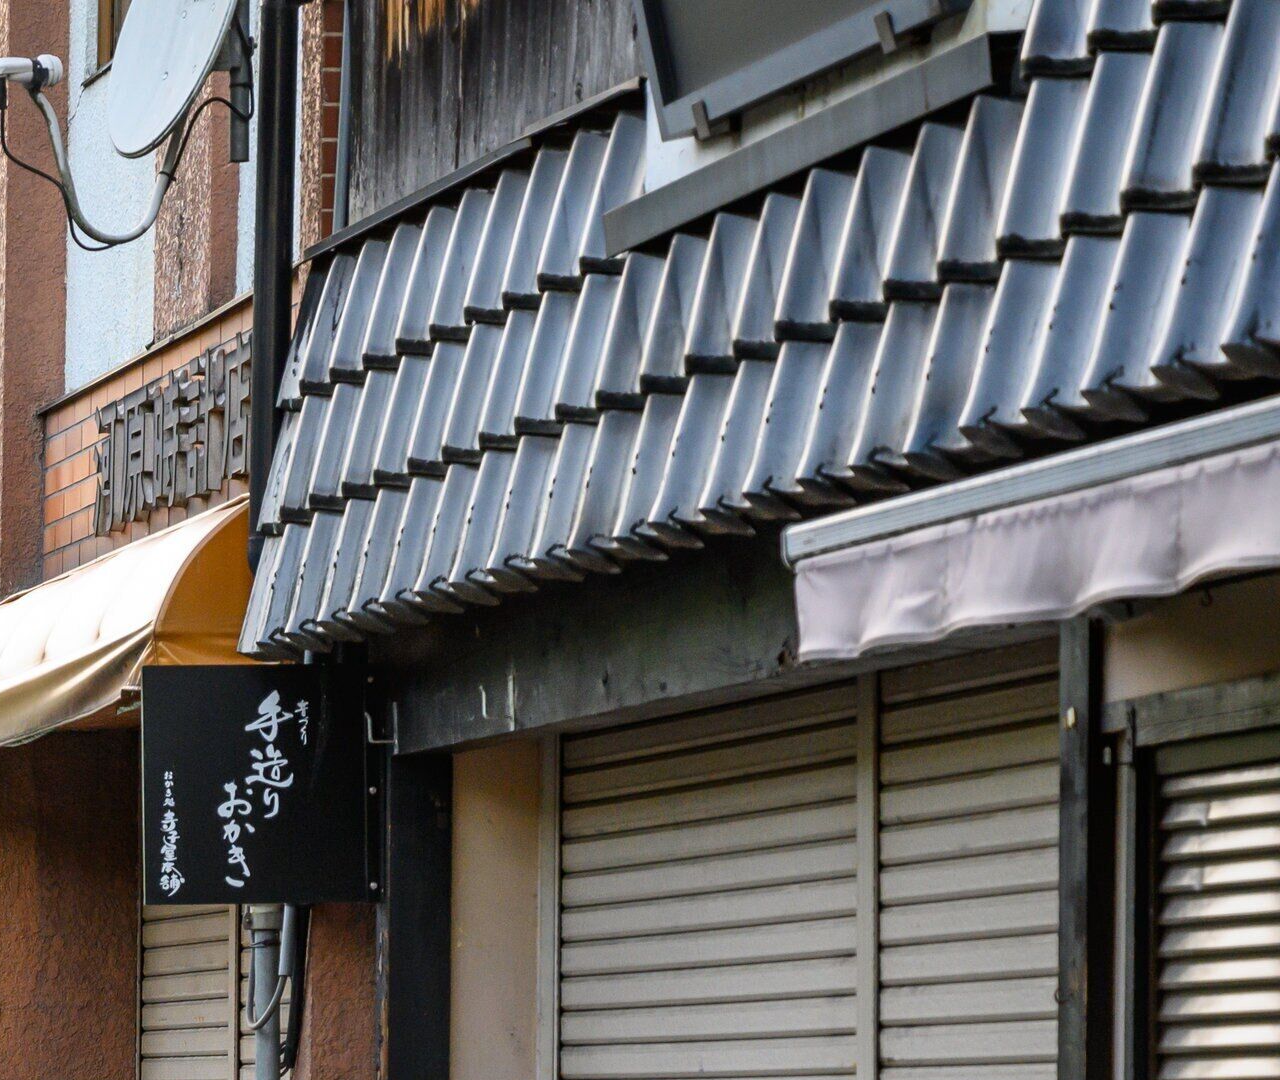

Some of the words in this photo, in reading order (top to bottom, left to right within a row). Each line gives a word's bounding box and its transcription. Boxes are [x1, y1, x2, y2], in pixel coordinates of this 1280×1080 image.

[245, 690, 294, 819] 手造り
[217, 780, 256, 888] おかき
